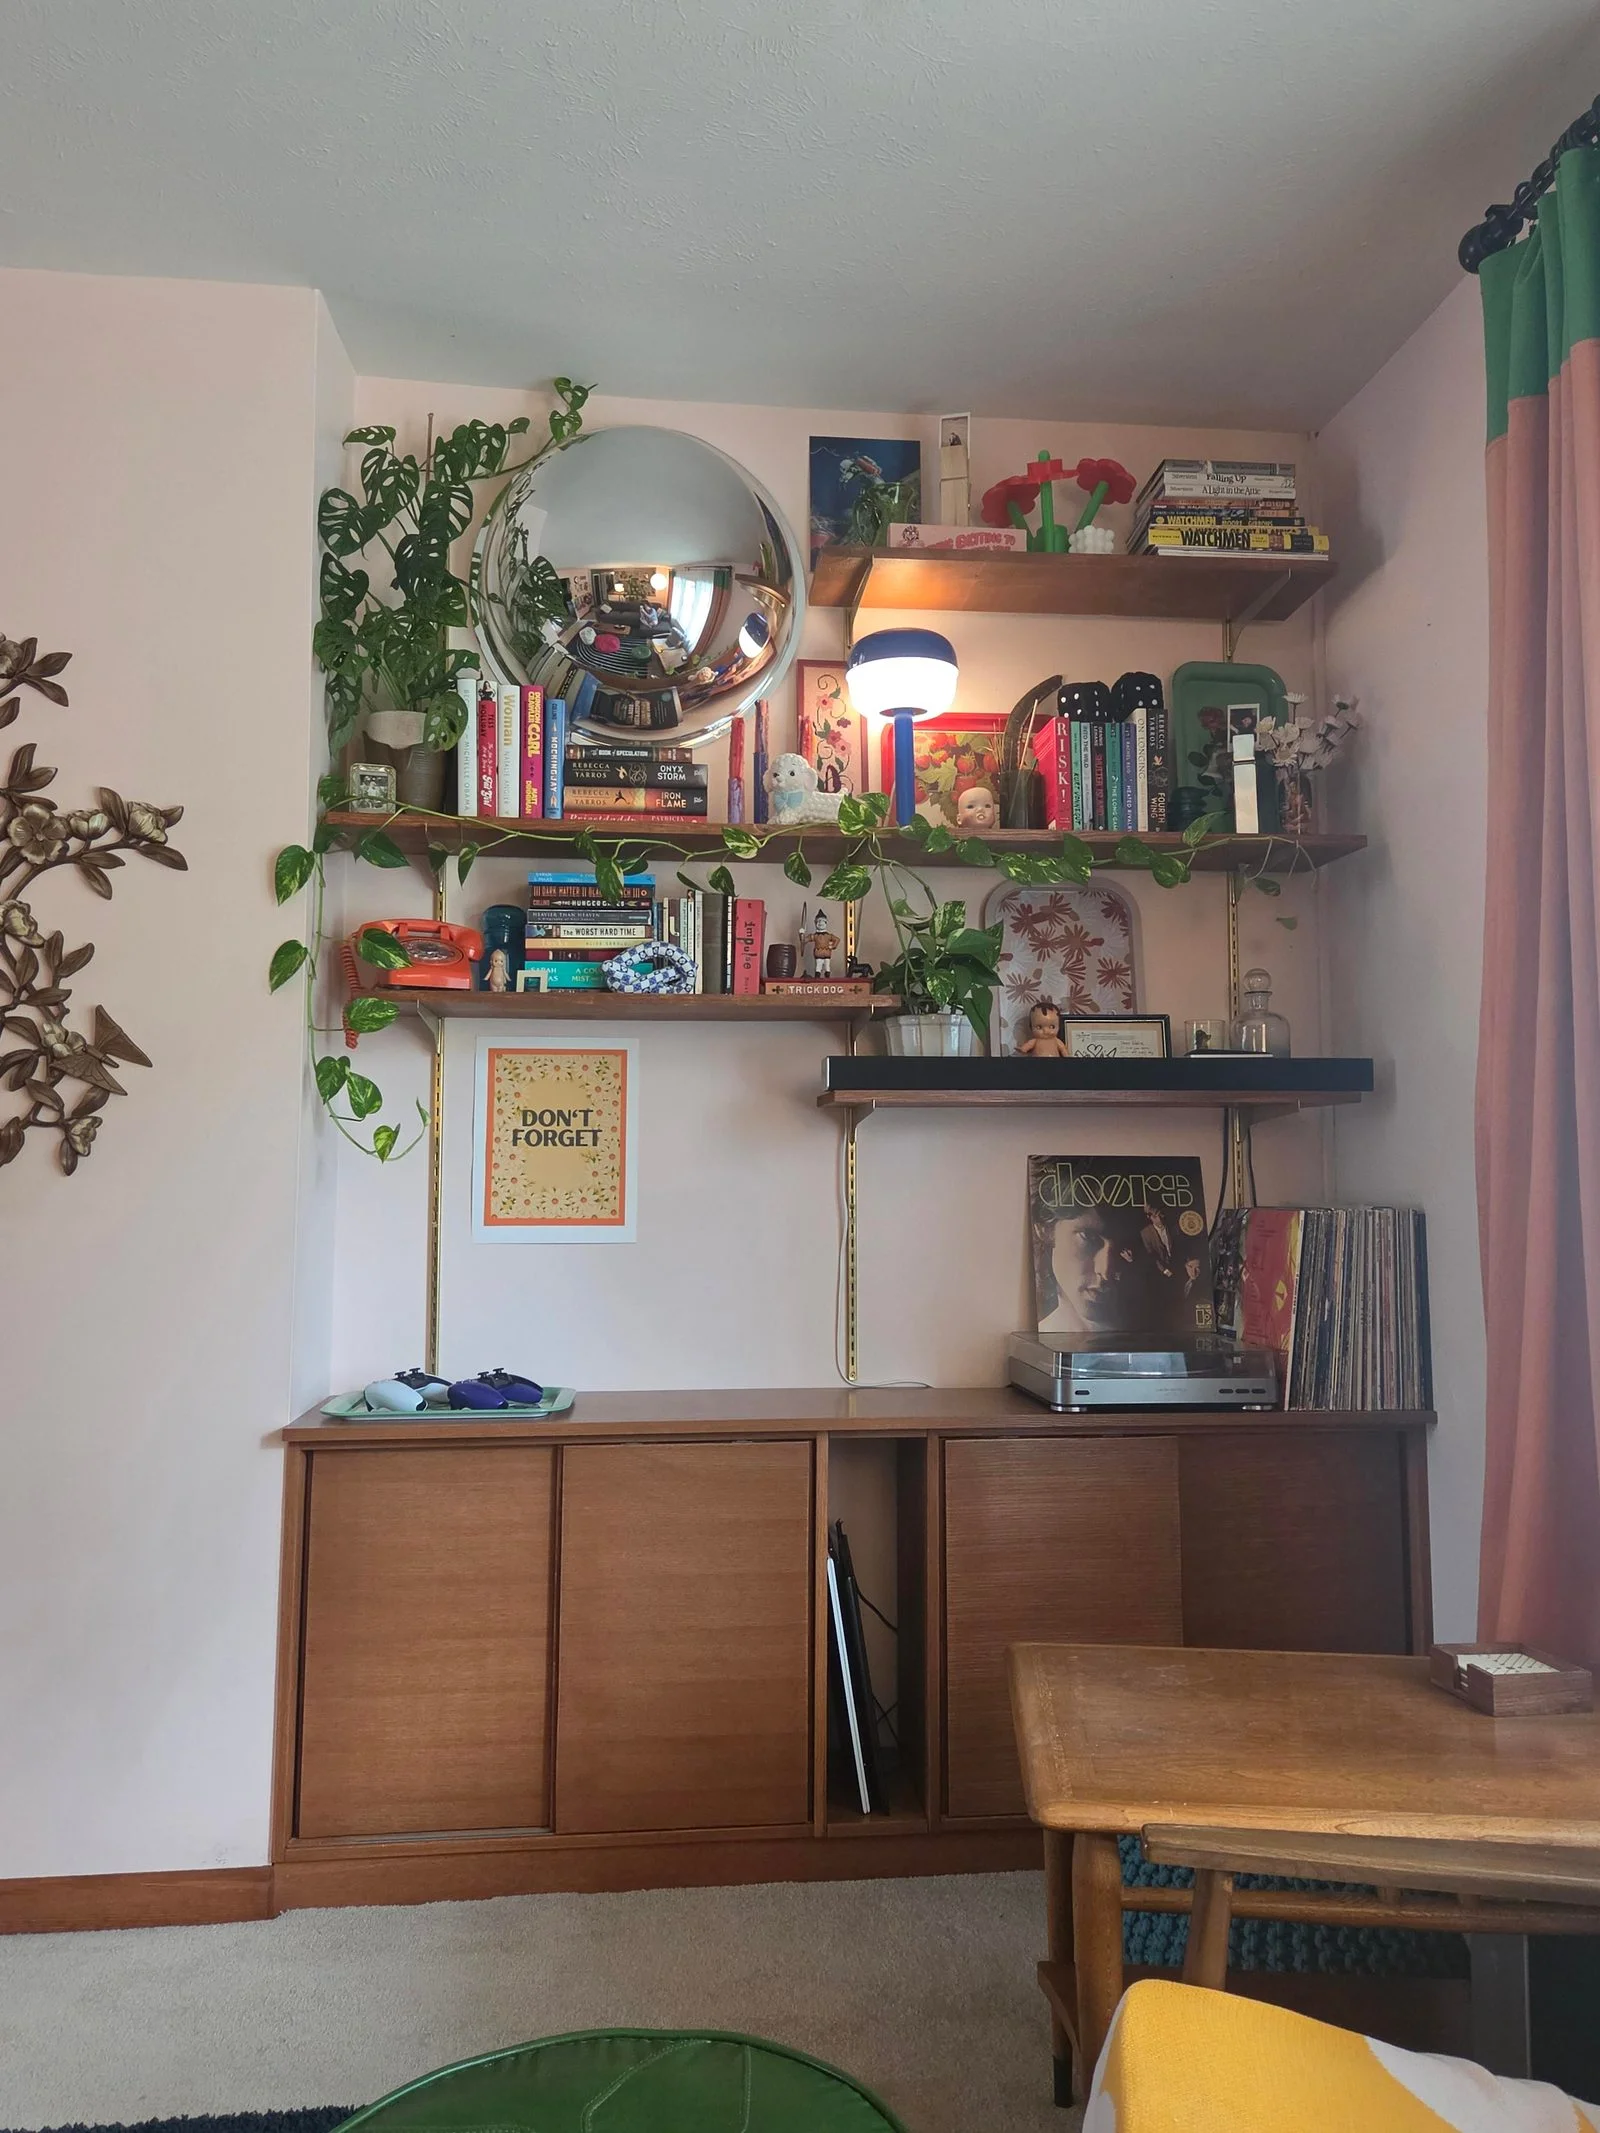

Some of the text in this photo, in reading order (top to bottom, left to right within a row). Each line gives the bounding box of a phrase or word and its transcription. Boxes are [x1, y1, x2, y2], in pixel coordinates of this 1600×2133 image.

[1206, 474, 1246, 484] Falling Up
[1208, 485, 1224, 496] Light
[1226, 486, 1233, 494] in
[1234, 486, 1245, 494] the
[1245, 487, 1261, 496] Attic
[1167, 516, 1216, 525] WATCHMEN
[1180, 530, 1250, 549] WATCHMEN
[503, 694, 516, 746] Woman
[1138, 718, 1145, 734] ON
[528, 723, 540, 757] CARL
[1057, 722, 1069, 803] RISK!
[788, 986, 820, 994] TRICK
[522, 1109, 594, 1127] DON'T
[512, 1129, 602, 1147] FORGET
